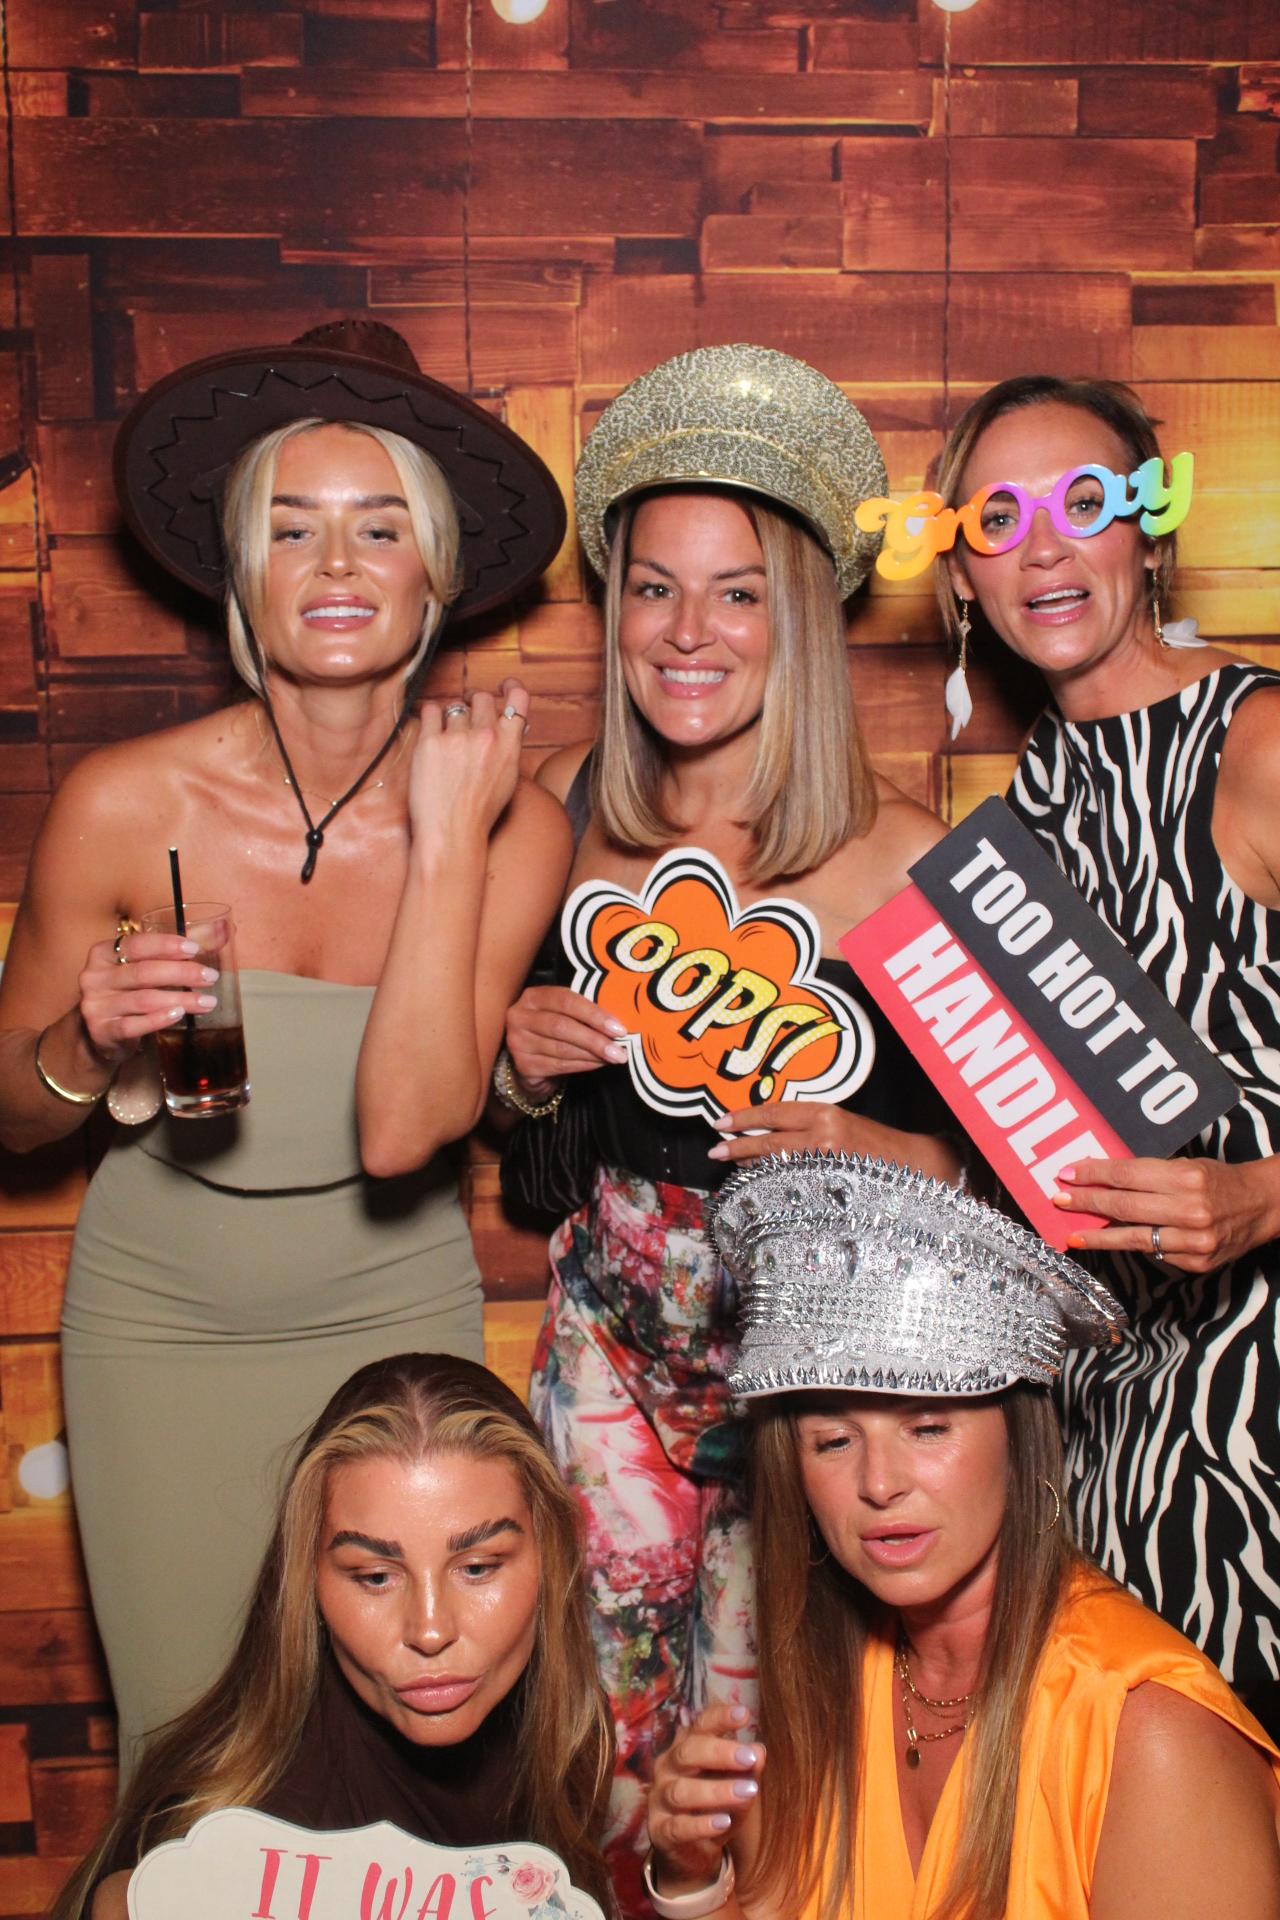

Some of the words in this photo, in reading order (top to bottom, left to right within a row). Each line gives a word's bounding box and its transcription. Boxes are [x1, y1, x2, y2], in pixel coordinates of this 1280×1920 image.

[606, 921, 849, 1105] OOPS!
[949, 837, 1053, 956] TOO
[1027, 938, 1145, 1056] HOT
[1116, 1037, 1199, 1125] TO
[251, 1848, 333, 1920] IT
